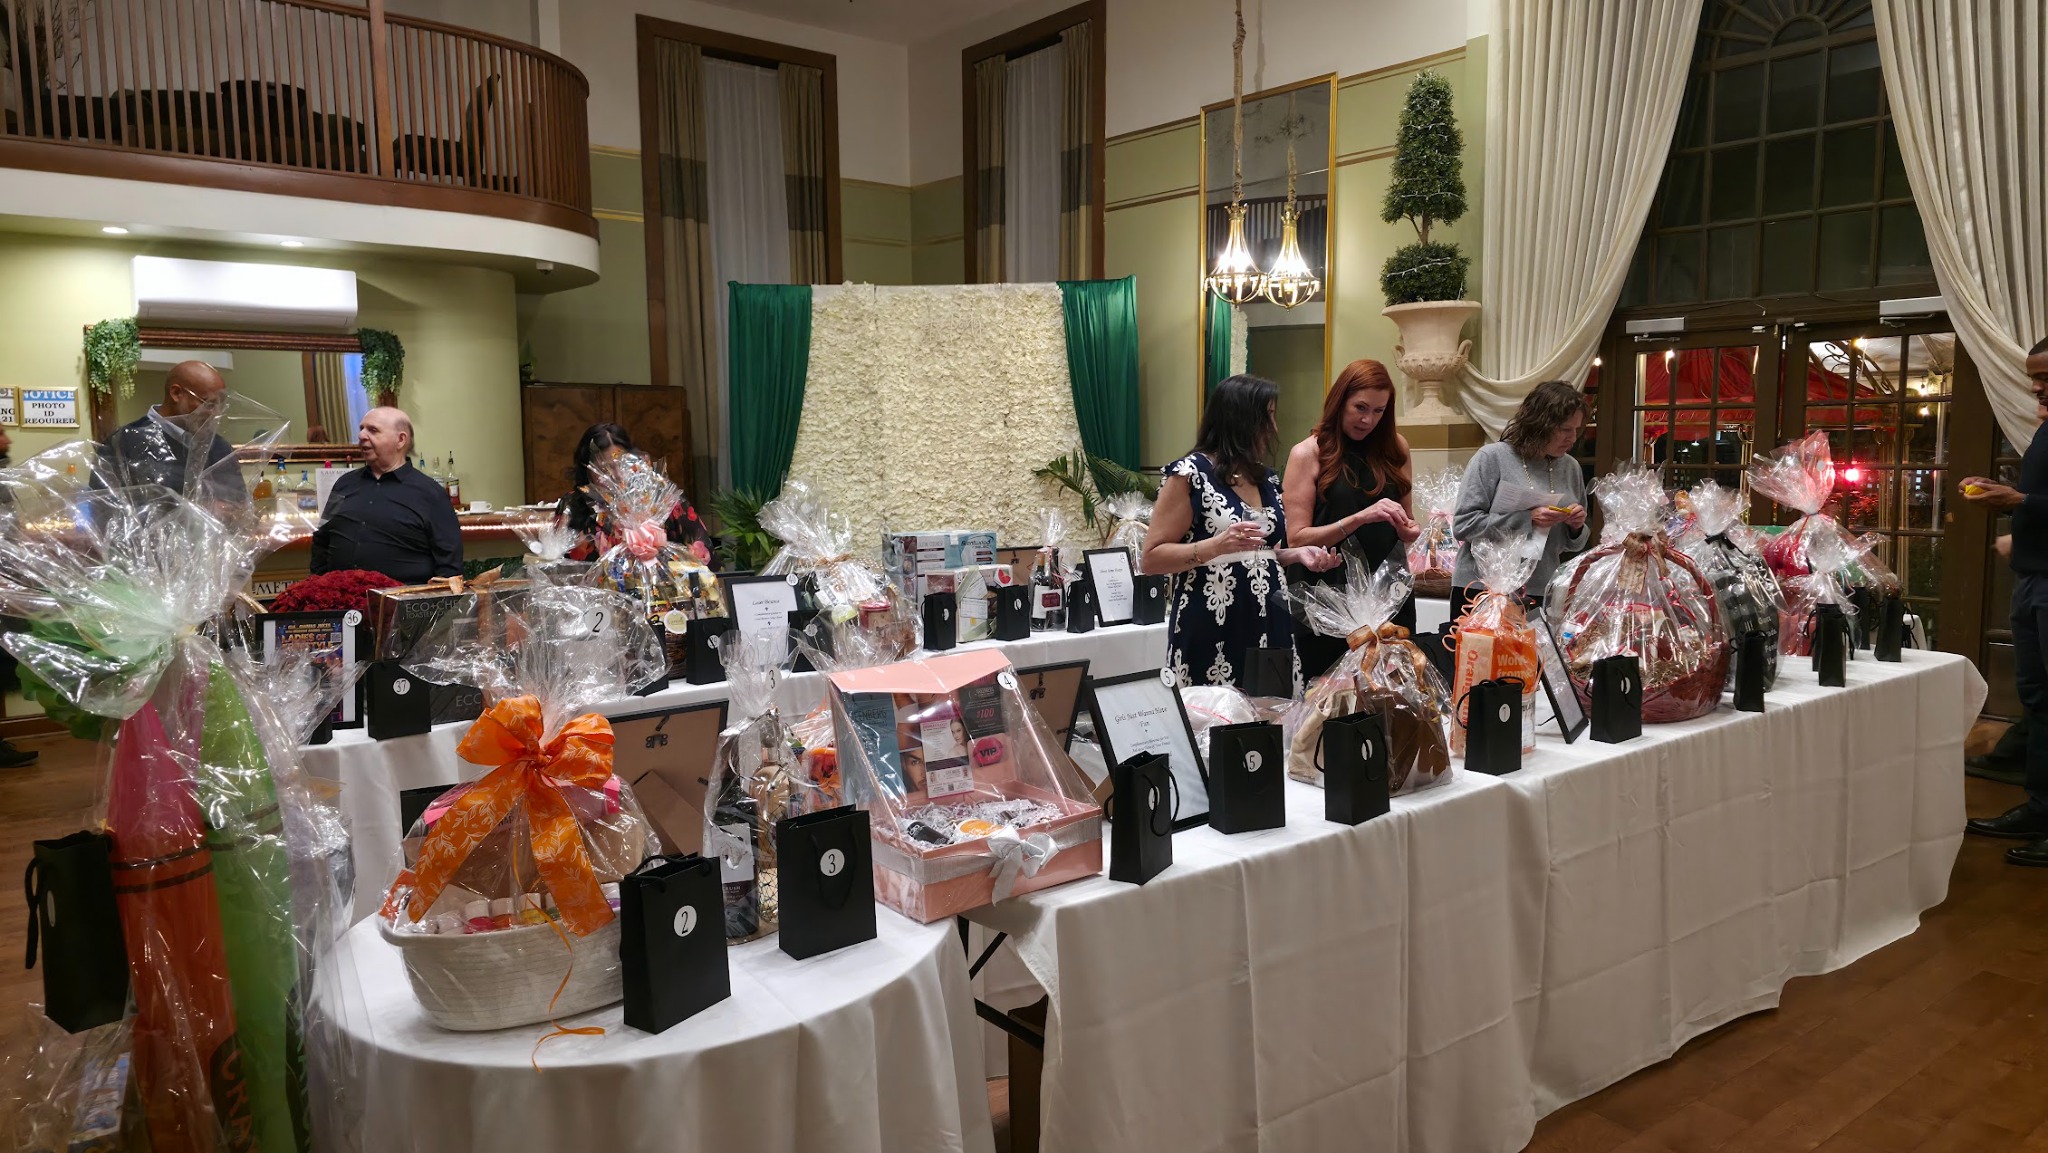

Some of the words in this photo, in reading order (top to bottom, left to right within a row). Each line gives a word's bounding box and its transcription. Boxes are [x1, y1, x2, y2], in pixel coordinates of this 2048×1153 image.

[24, 390, 75, 399] NOTICE
[256, 580, 291, 595] MET
[346, 612, 359, 624] 36
[591, 611, 604, 633] 2
[768, 669, 776, 689] 3
[1003, 675, 1013, 688] 4
[1164, 670, 1171, 685] 5
[395, 680, 407, 693] 37
[979, 747, 997, 758] VIP
[1249, 754, 1256, 771] 5
[827, 853, 836, 874] 3
[681, 910, 689, 935] 2
